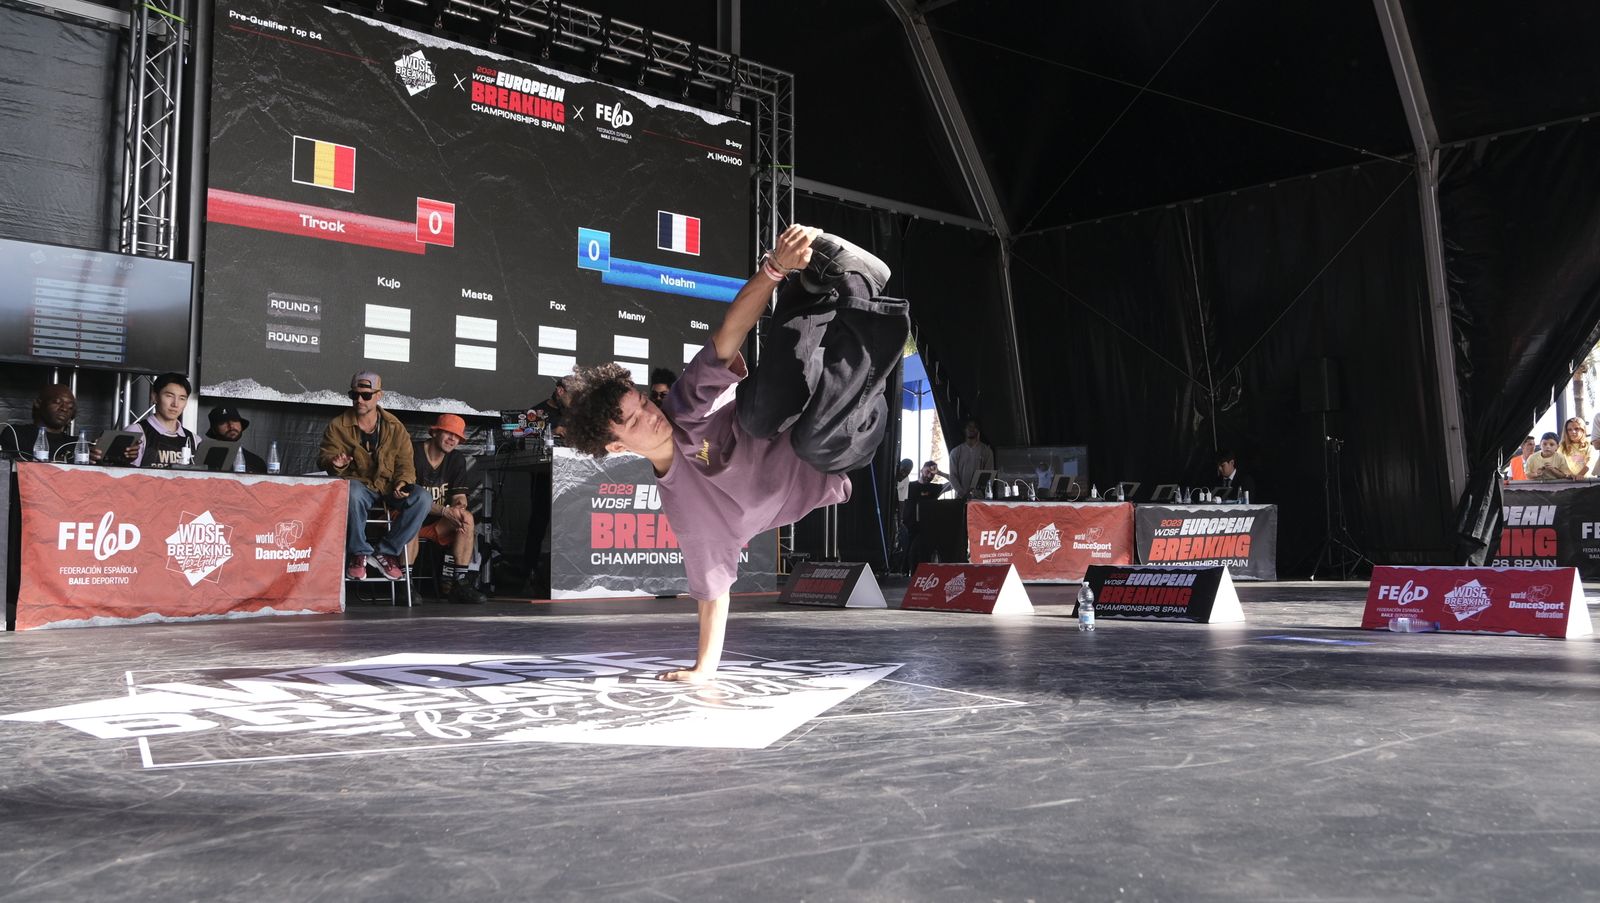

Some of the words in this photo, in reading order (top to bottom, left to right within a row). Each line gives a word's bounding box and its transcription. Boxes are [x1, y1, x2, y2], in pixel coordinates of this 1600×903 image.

[228, 9, 289, 32] Pre-Qualifier
[290, 26, 307, 39] Top
[308, 32, 323, 42] 64
[402, 54, 432, 73] WDSF
[395, 66, 436, 83] BREAKING
[471, 72, 496, 85] WDSF
[496, 71, 566, 103] EUROPEAN
[471, 80, 566, 124] BREAKING
[470, 103, 540, 126] CHAMPIONSHIPS
[541, 120, 566, 133] SPAIN
[428, 211, 443, 235] 0
[588, 239, 600, 262] 0
[377, 276, 401, 290] Kujo
[660, 274, 696, 290] Noahm
[270, 299, 311, 314] ROUND
[312, 304, 319, 314] 1
[550, 300, 567, 312] Fox
[618, 309, 646, 324] Manny
[268, 331, 308, 345] ROUND
[310, 336, 319, 346] 2
[598, 483, 634, 495] 2023
[591, 497, 632, 509] WDSF
[591, 512, 680, 549] BREA
[1154, 528, 1181, 536] WDSF
[1179, 516, 1256, 536] EUROPEAN
[1160, 519, 1184, 528] 2023
[179, 523, 225, 544] WDSF
[255, 532, 275, 544] world
[1035, 529, 1060, 540] WDSF
[167, 544, 232, 557] BREAKING
[1028, 540, 1062, 548] BREAKING
[1073, 541, 1112, 551] DanceSport
[1148, 534, 1251, 561] BREAKING
[255, 547, 312, 562] DanceSport
[59, 565, 102, 575] FEDERACIÓN
[103, 565, 138, 575] ESPAÑOLA
[1513, 559, 1557, 568] SPAIN
[68, 577, 90, 585] BAILE
[91, 577, 129, 585] DEPORTIVO
[1125, 573, 1197, 587] EUROPEAN
[1099, 585, 1193, 606] BREAKING
[1454, 586, 1488, 598] WDSF
[1510, 591, 1527, 600] world
[1095, 603, 1161, 613] CHAMPIONSHIPS
[1161, 606, 1188, 614] SPAIN
[1444, 597, 1491, 606] BREAKING
[1508, 600, 1565, 611] DanceSport
[56, 659, 878, 740] BREAKNG
